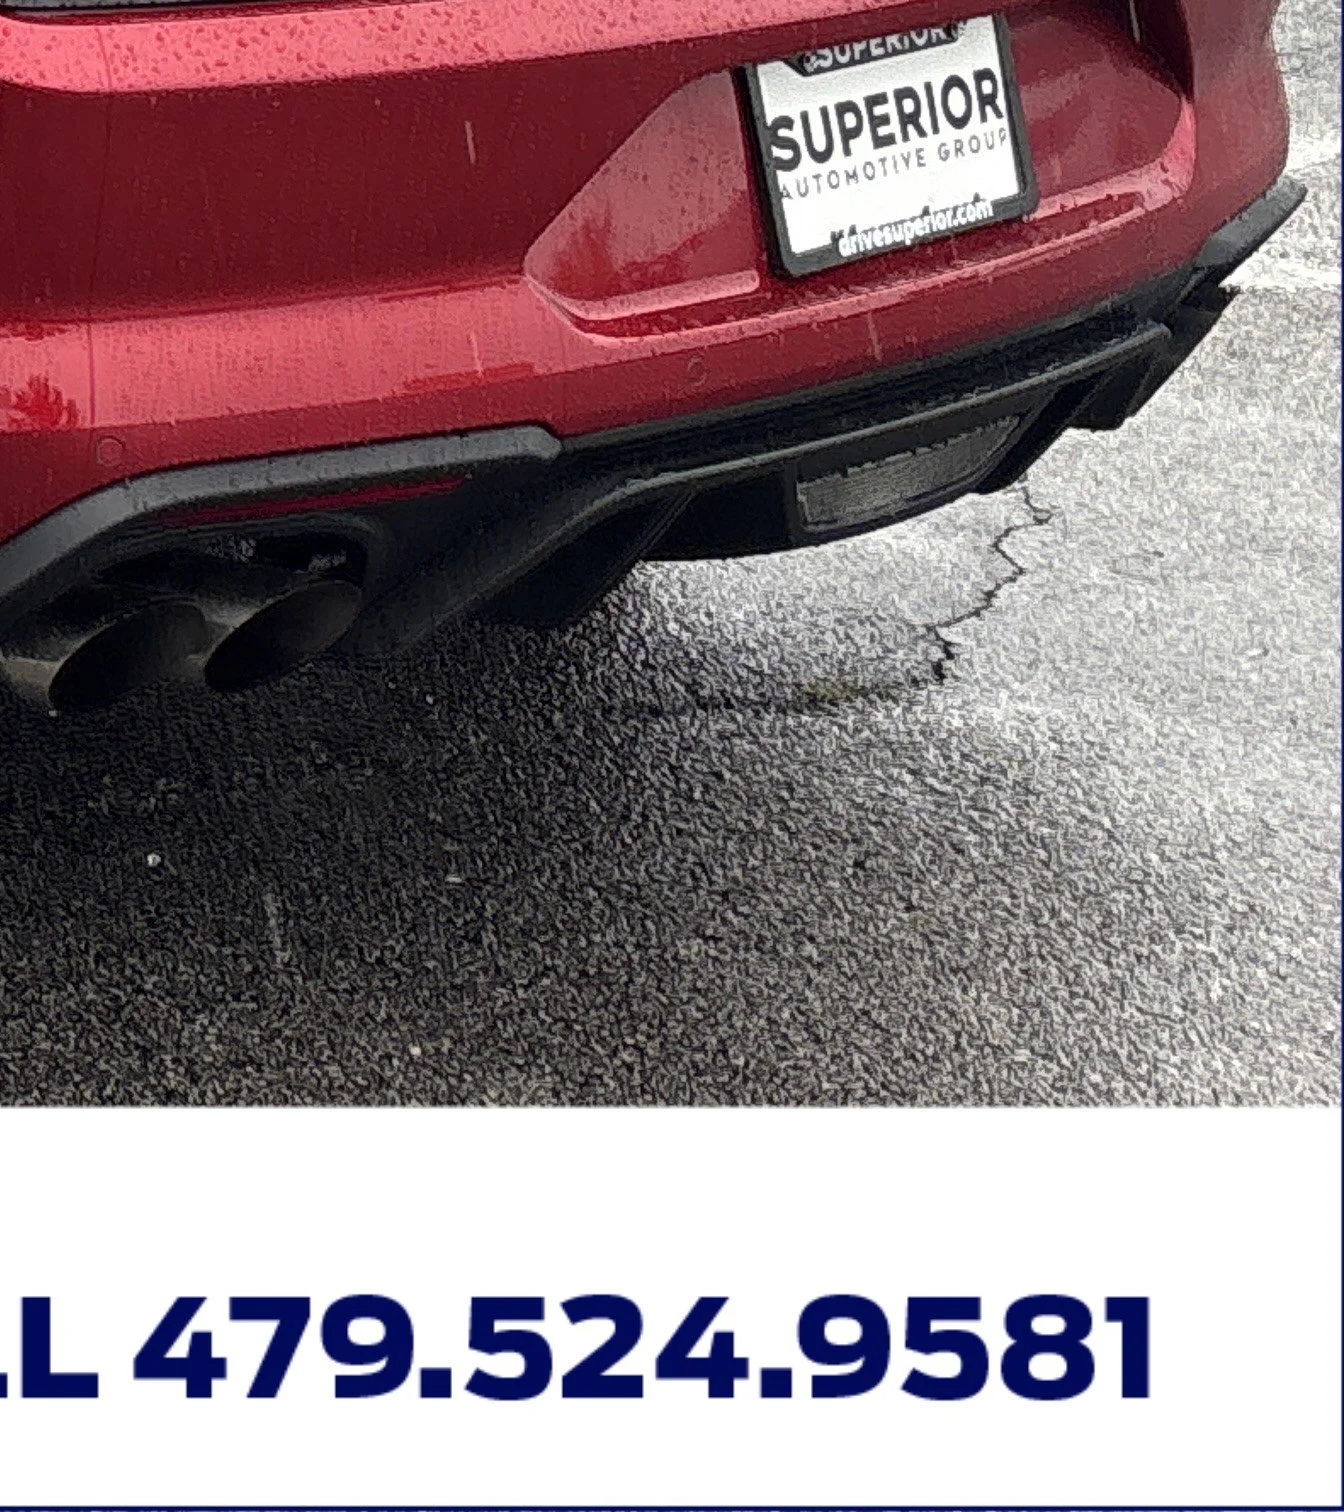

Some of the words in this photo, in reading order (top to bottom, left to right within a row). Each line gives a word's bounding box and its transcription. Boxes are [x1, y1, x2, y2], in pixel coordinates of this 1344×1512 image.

[764, 67, 1004, 172] SUPERIOR
[779, 147, 928, 201] AUTOMOTIVE
[937, 127, 1008, 163] GROUP
